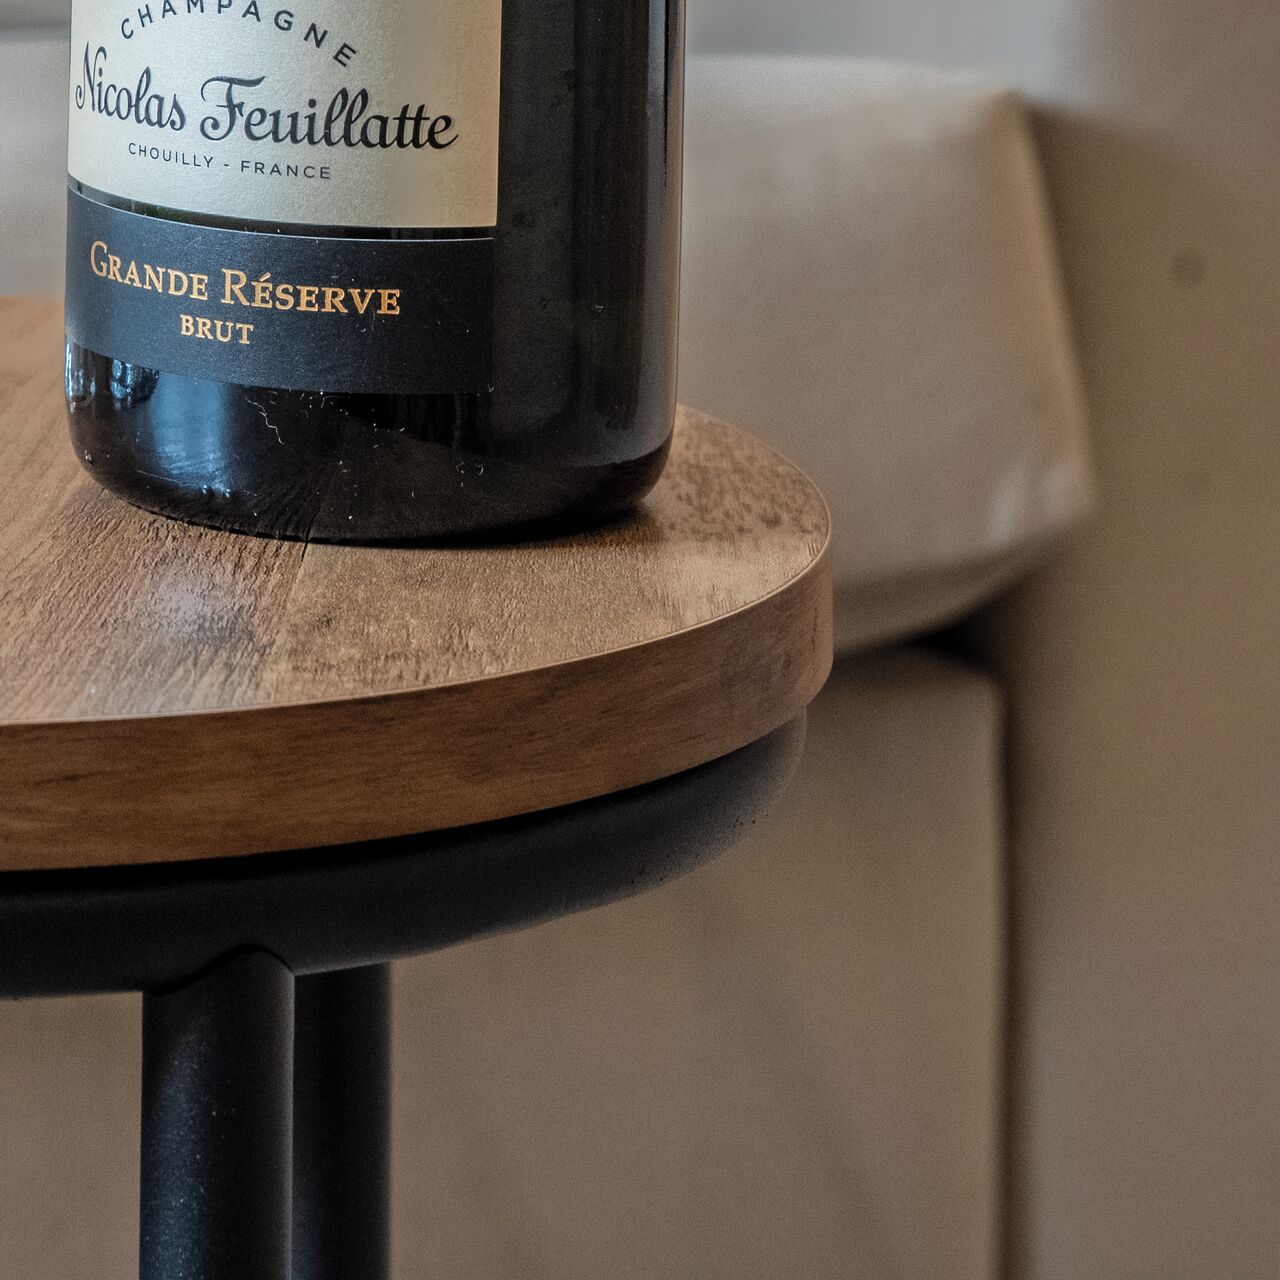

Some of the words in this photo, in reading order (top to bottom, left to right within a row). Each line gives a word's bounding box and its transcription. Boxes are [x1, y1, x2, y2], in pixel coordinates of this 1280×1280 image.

[75, 41, 187, 131] Nicolas
[199, 75, 460, 150] Feuillatte
[127, 142, 215, 170] CHOUILLY
[240, 159, 332, 181] FRANCE
[89, 239, 209, 301] GRANDE
[220, 267, 402, 316] RÉSERVE
[179, 313, 255, 345] BRUT
